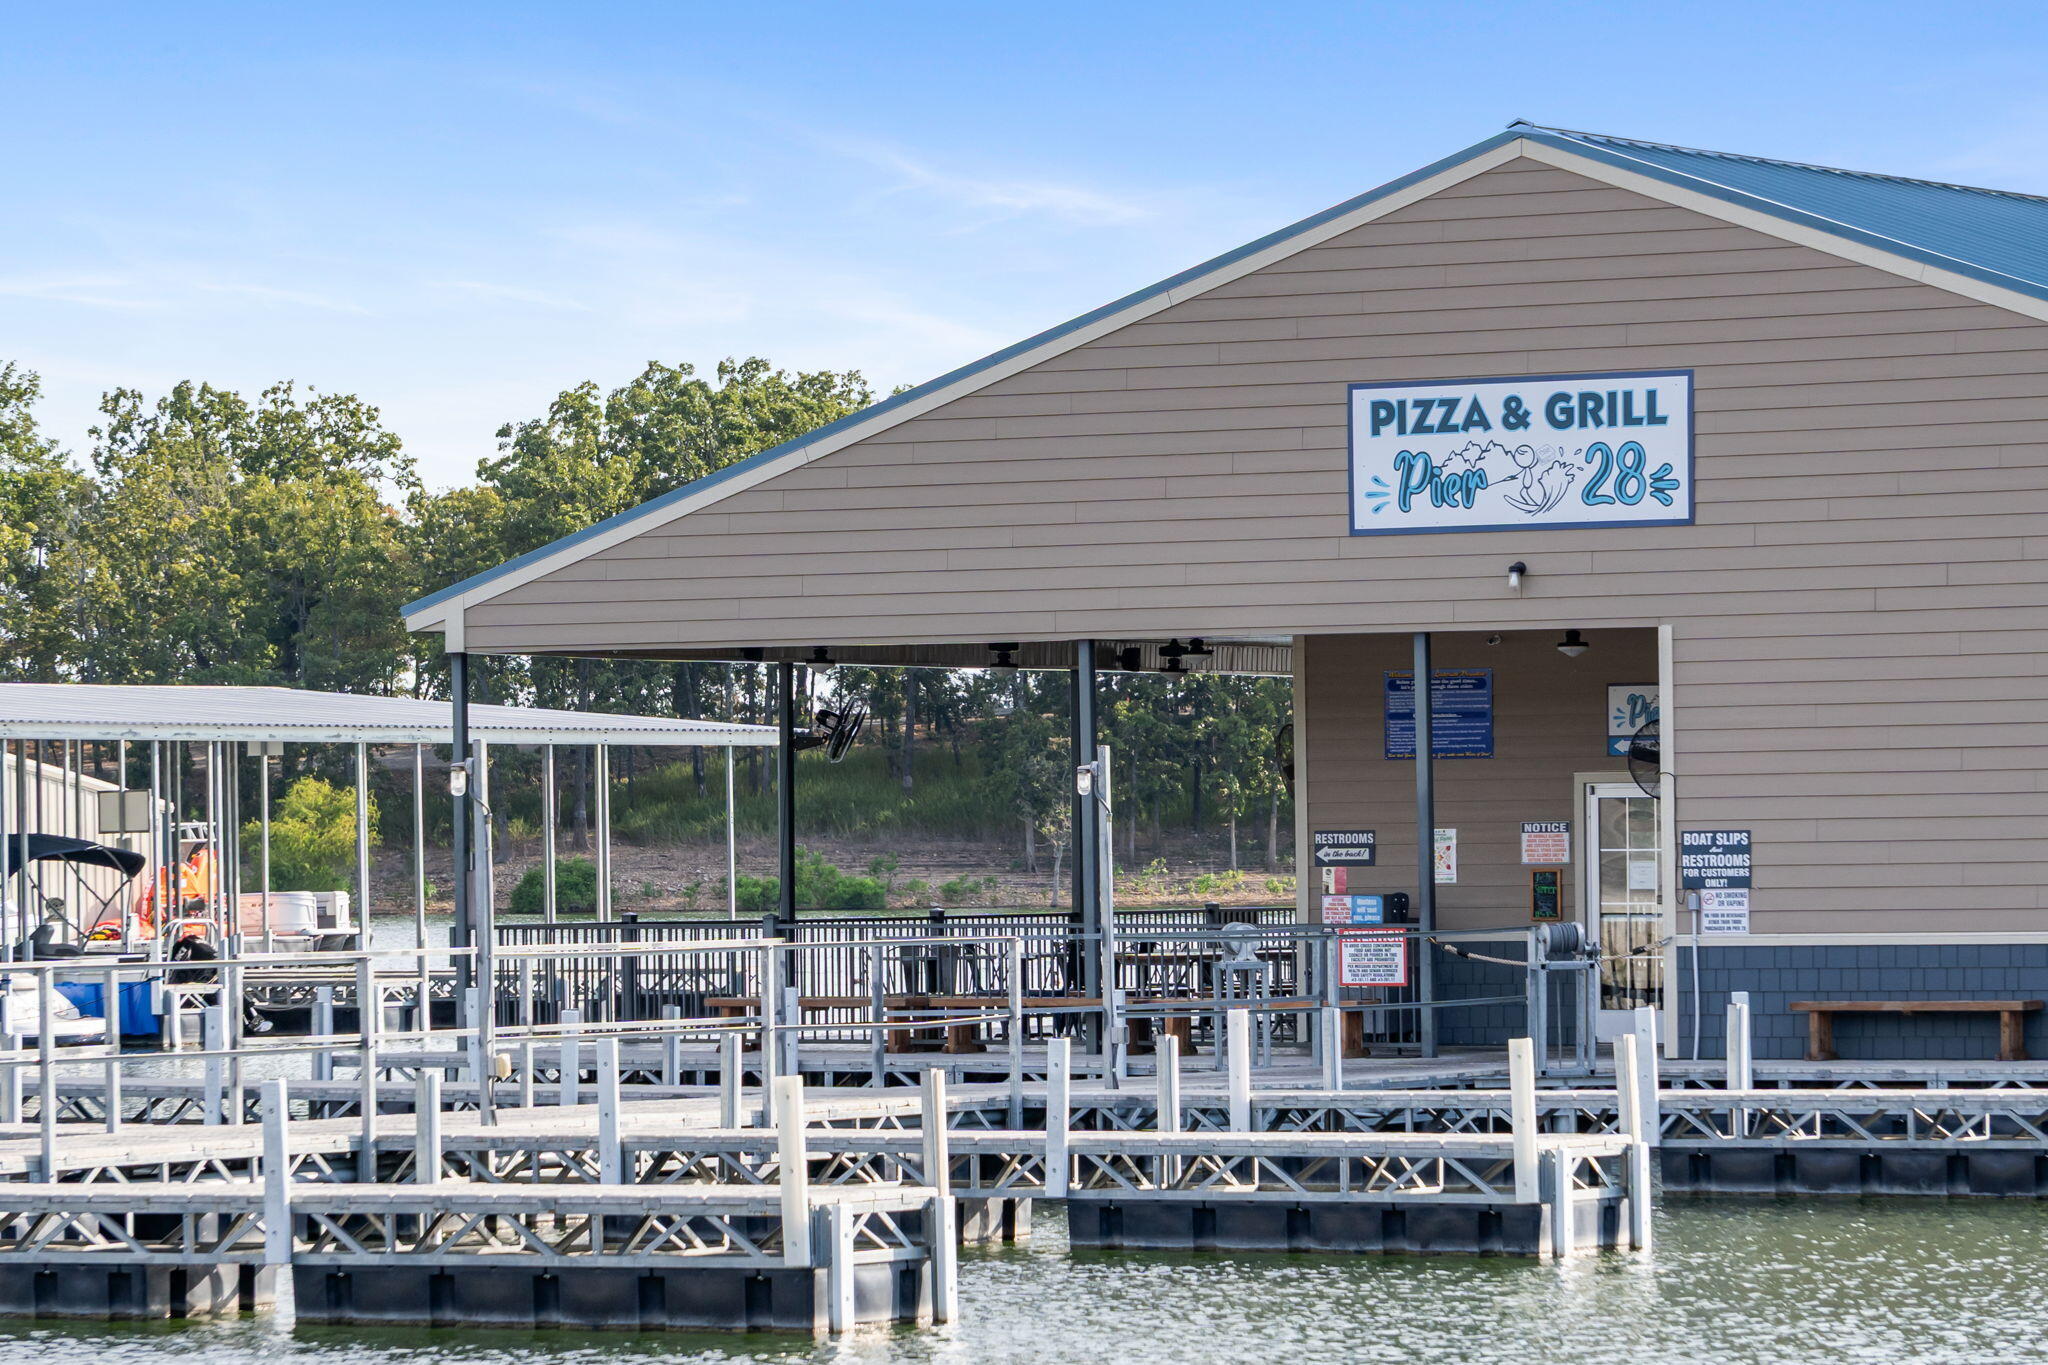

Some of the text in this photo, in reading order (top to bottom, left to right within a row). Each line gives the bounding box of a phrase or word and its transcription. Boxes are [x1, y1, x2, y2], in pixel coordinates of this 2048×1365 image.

[1369, 386, 1669, 438] PIZZA & GRILL
[1394, 440, 1646, 513] Pier 28
[1524, 823, 1567, 832] NOTICE
[1315, 833, 1374, 844] RESTROOMS
[1683, 832, 1749, 845] BOAT SLIPS
[1344, 849, 1367, 857] back!
[1682, 854, 1750, 867] RESTROOMS
[1683, 868, 1750, 877] FOR CUSTOMERS
[1705, 879, 1728, 888] ONLY!
[1341, 930, 1404, 942] ATTENTION
